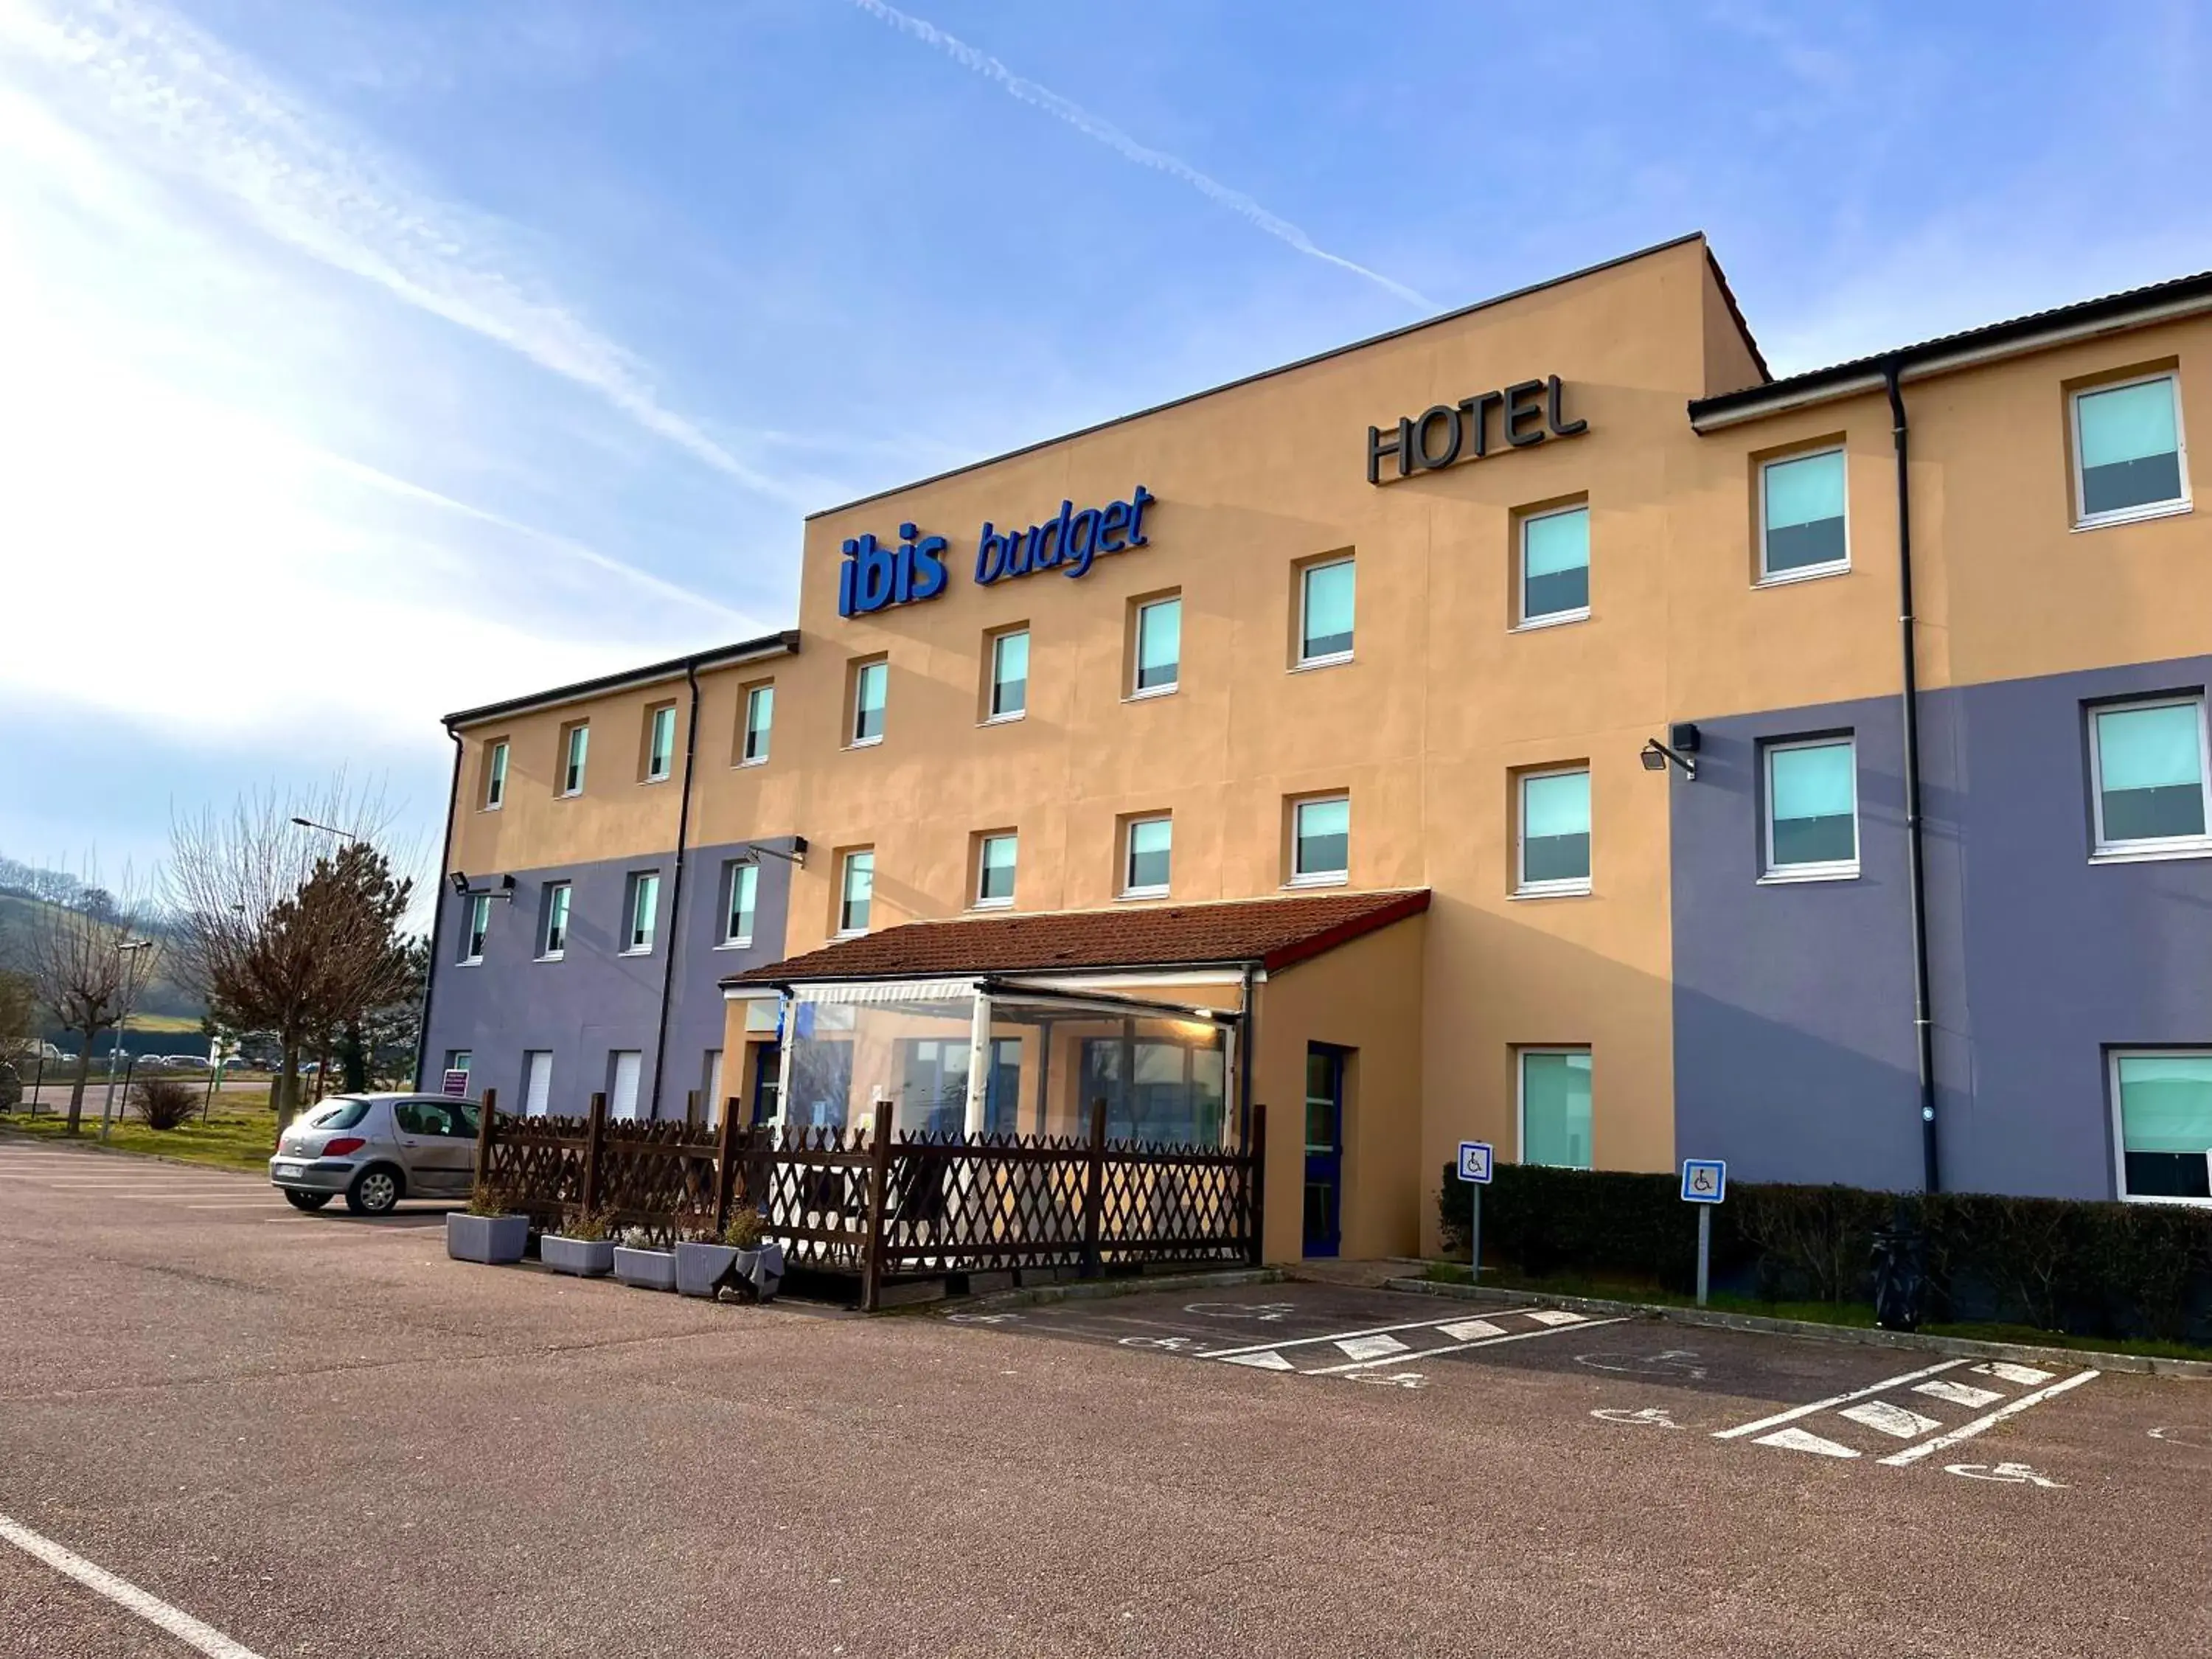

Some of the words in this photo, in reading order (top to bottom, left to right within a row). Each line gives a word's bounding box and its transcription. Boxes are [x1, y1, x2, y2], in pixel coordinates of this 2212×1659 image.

[1368, 374, 1587, 484] HOTEL
[838, 522, 948, 617] ibis
[974, 484, 1155, 585] budget
